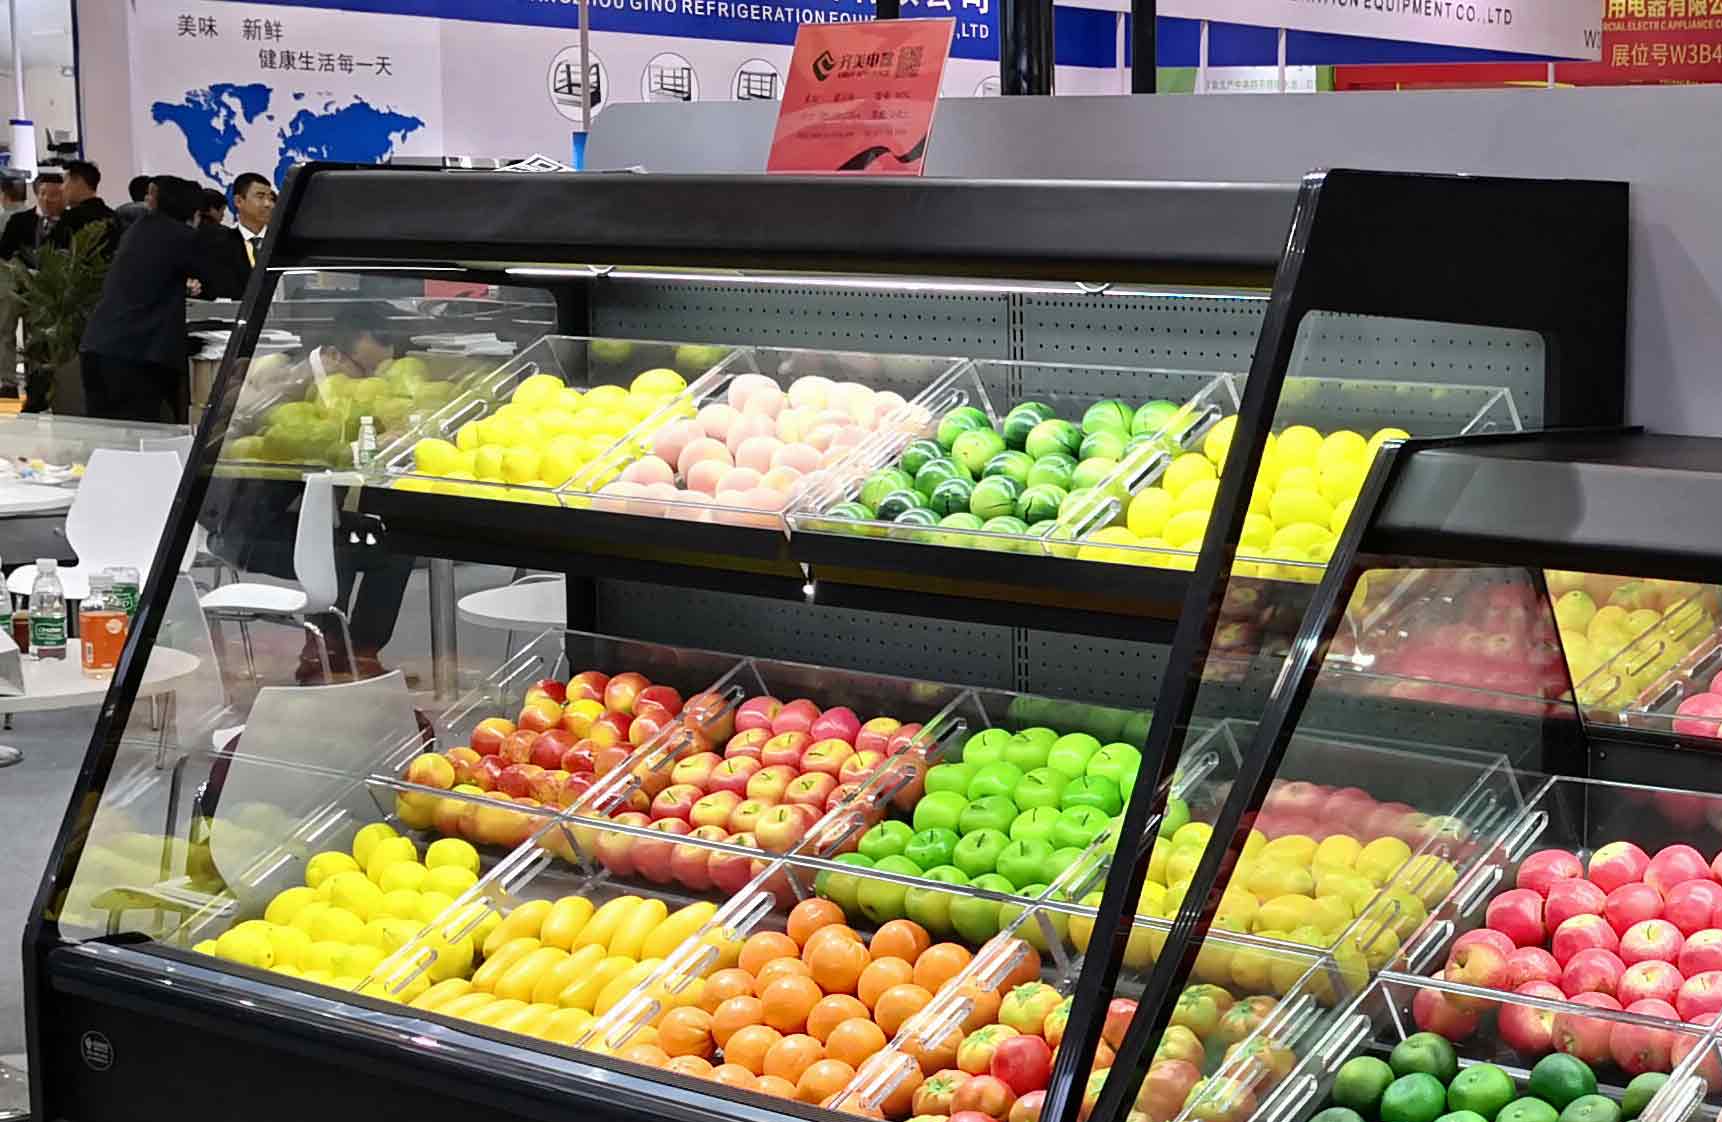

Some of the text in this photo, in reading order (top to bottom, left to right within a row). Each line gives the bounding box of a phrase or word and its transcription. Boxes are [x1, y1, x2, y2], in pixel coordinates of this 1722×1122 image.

[630, 0, 678, 13] GINO
[682, 0, 825, 24] REFRIGERATION
[178, 14, 284, 42] 美味 新鲜
[258, 48, 393, 76] 健康生活每一天
